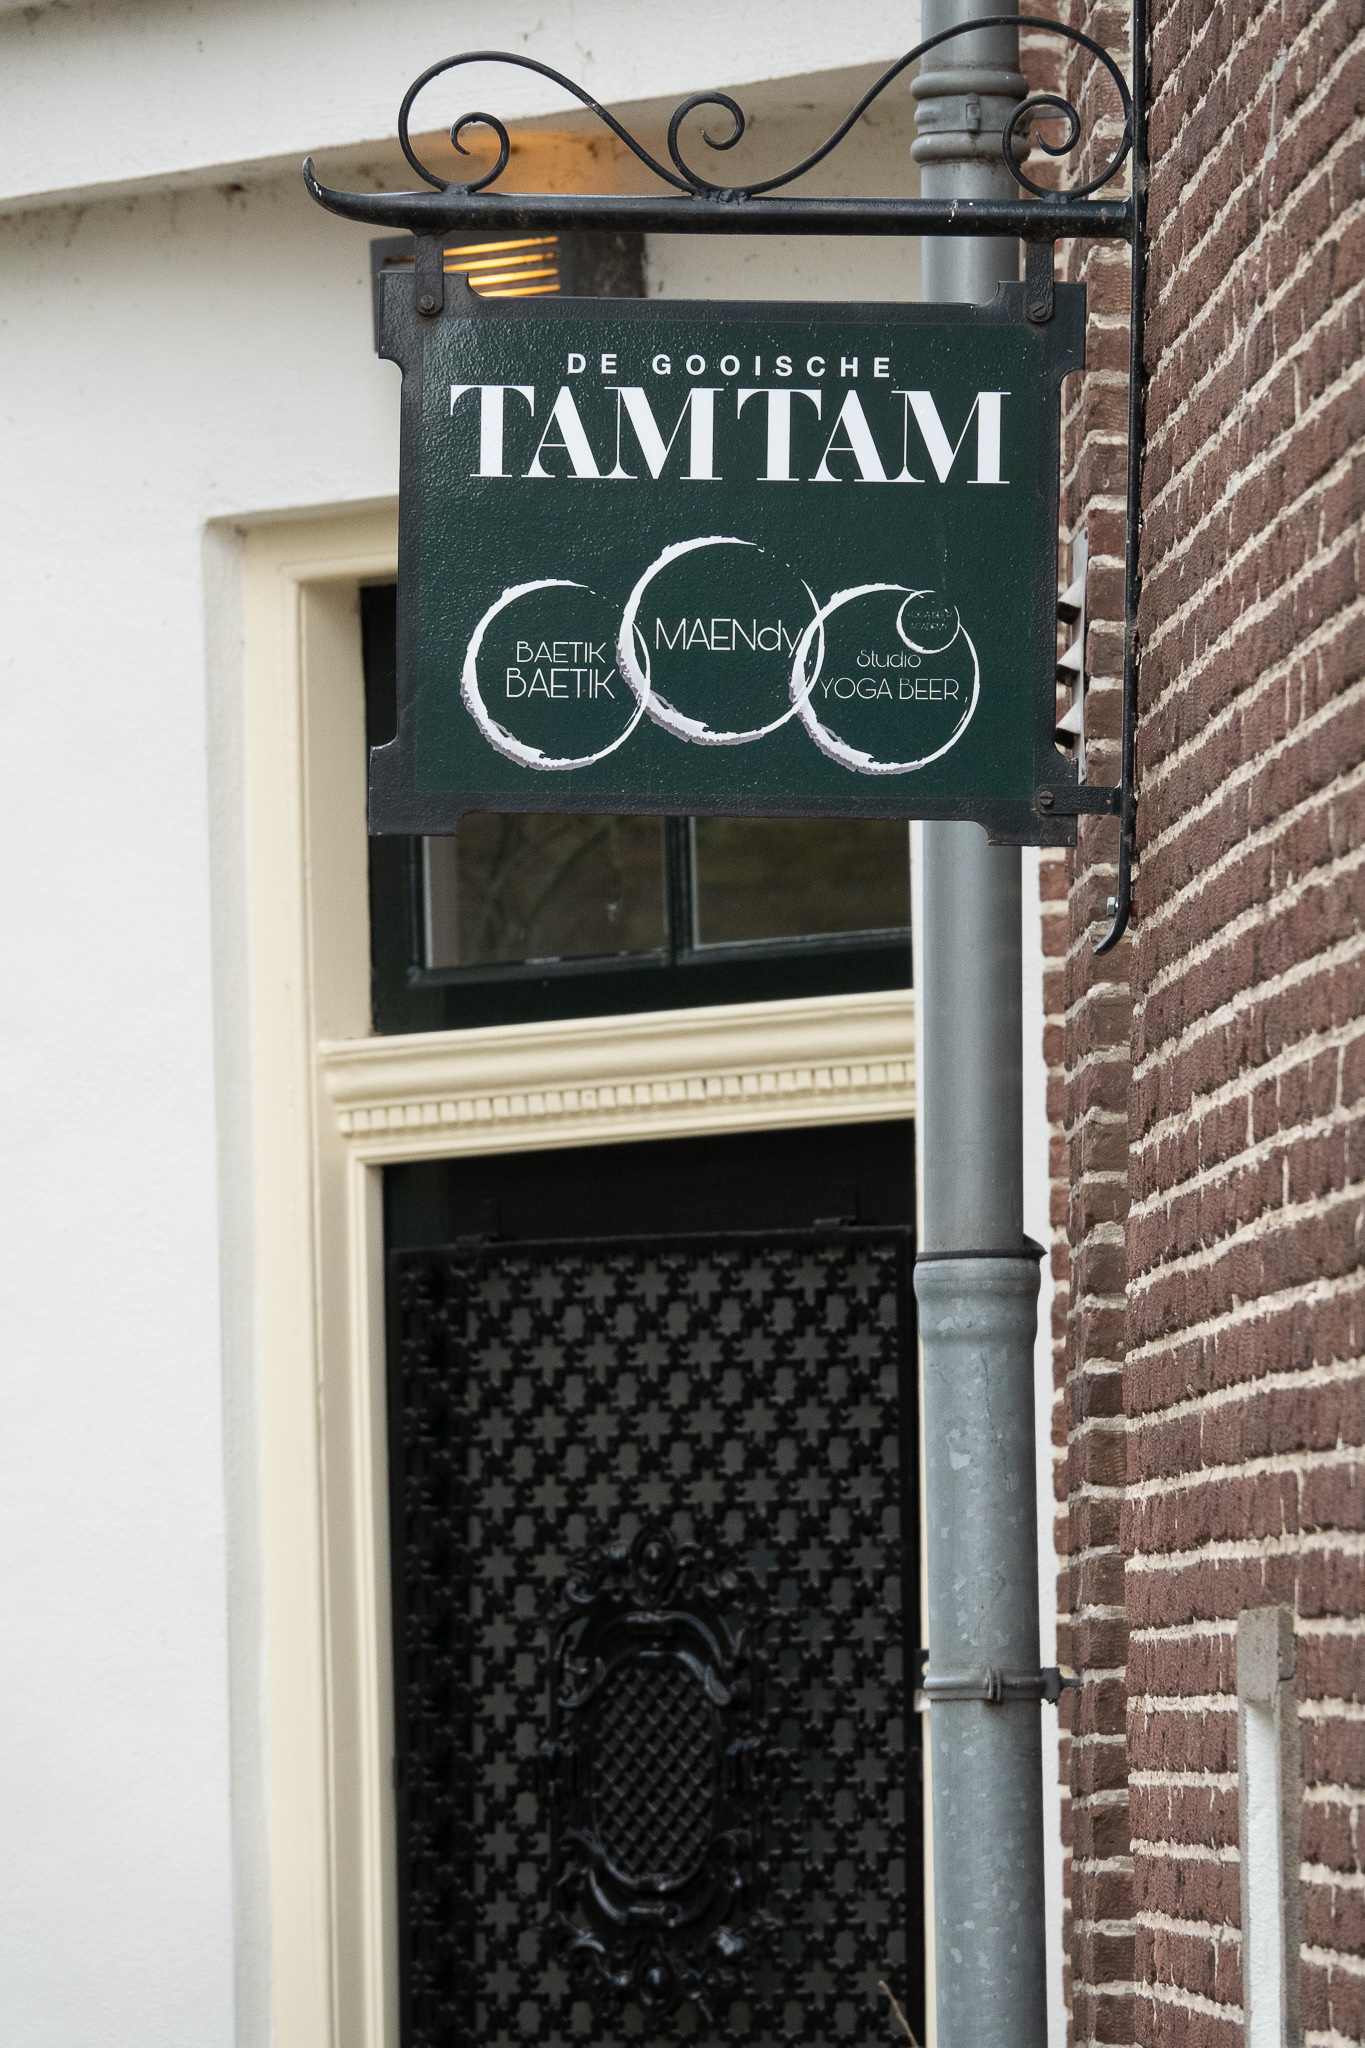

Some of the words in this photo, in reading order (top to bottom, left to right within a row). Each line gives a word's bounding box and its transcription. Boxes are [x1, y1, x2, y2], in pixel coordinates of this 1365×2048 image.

[567, 353, 618, 374] DE
[652, 354, 892, 378] GOOISCHE
[516, 641, 606, 664] BAETIK
[856, 650, 922, 668] Studio
[506, 668, 616, 699] BAETIK
[820, 678, 893, 700] YOGA
[899, 678, 960, 701] BEER
